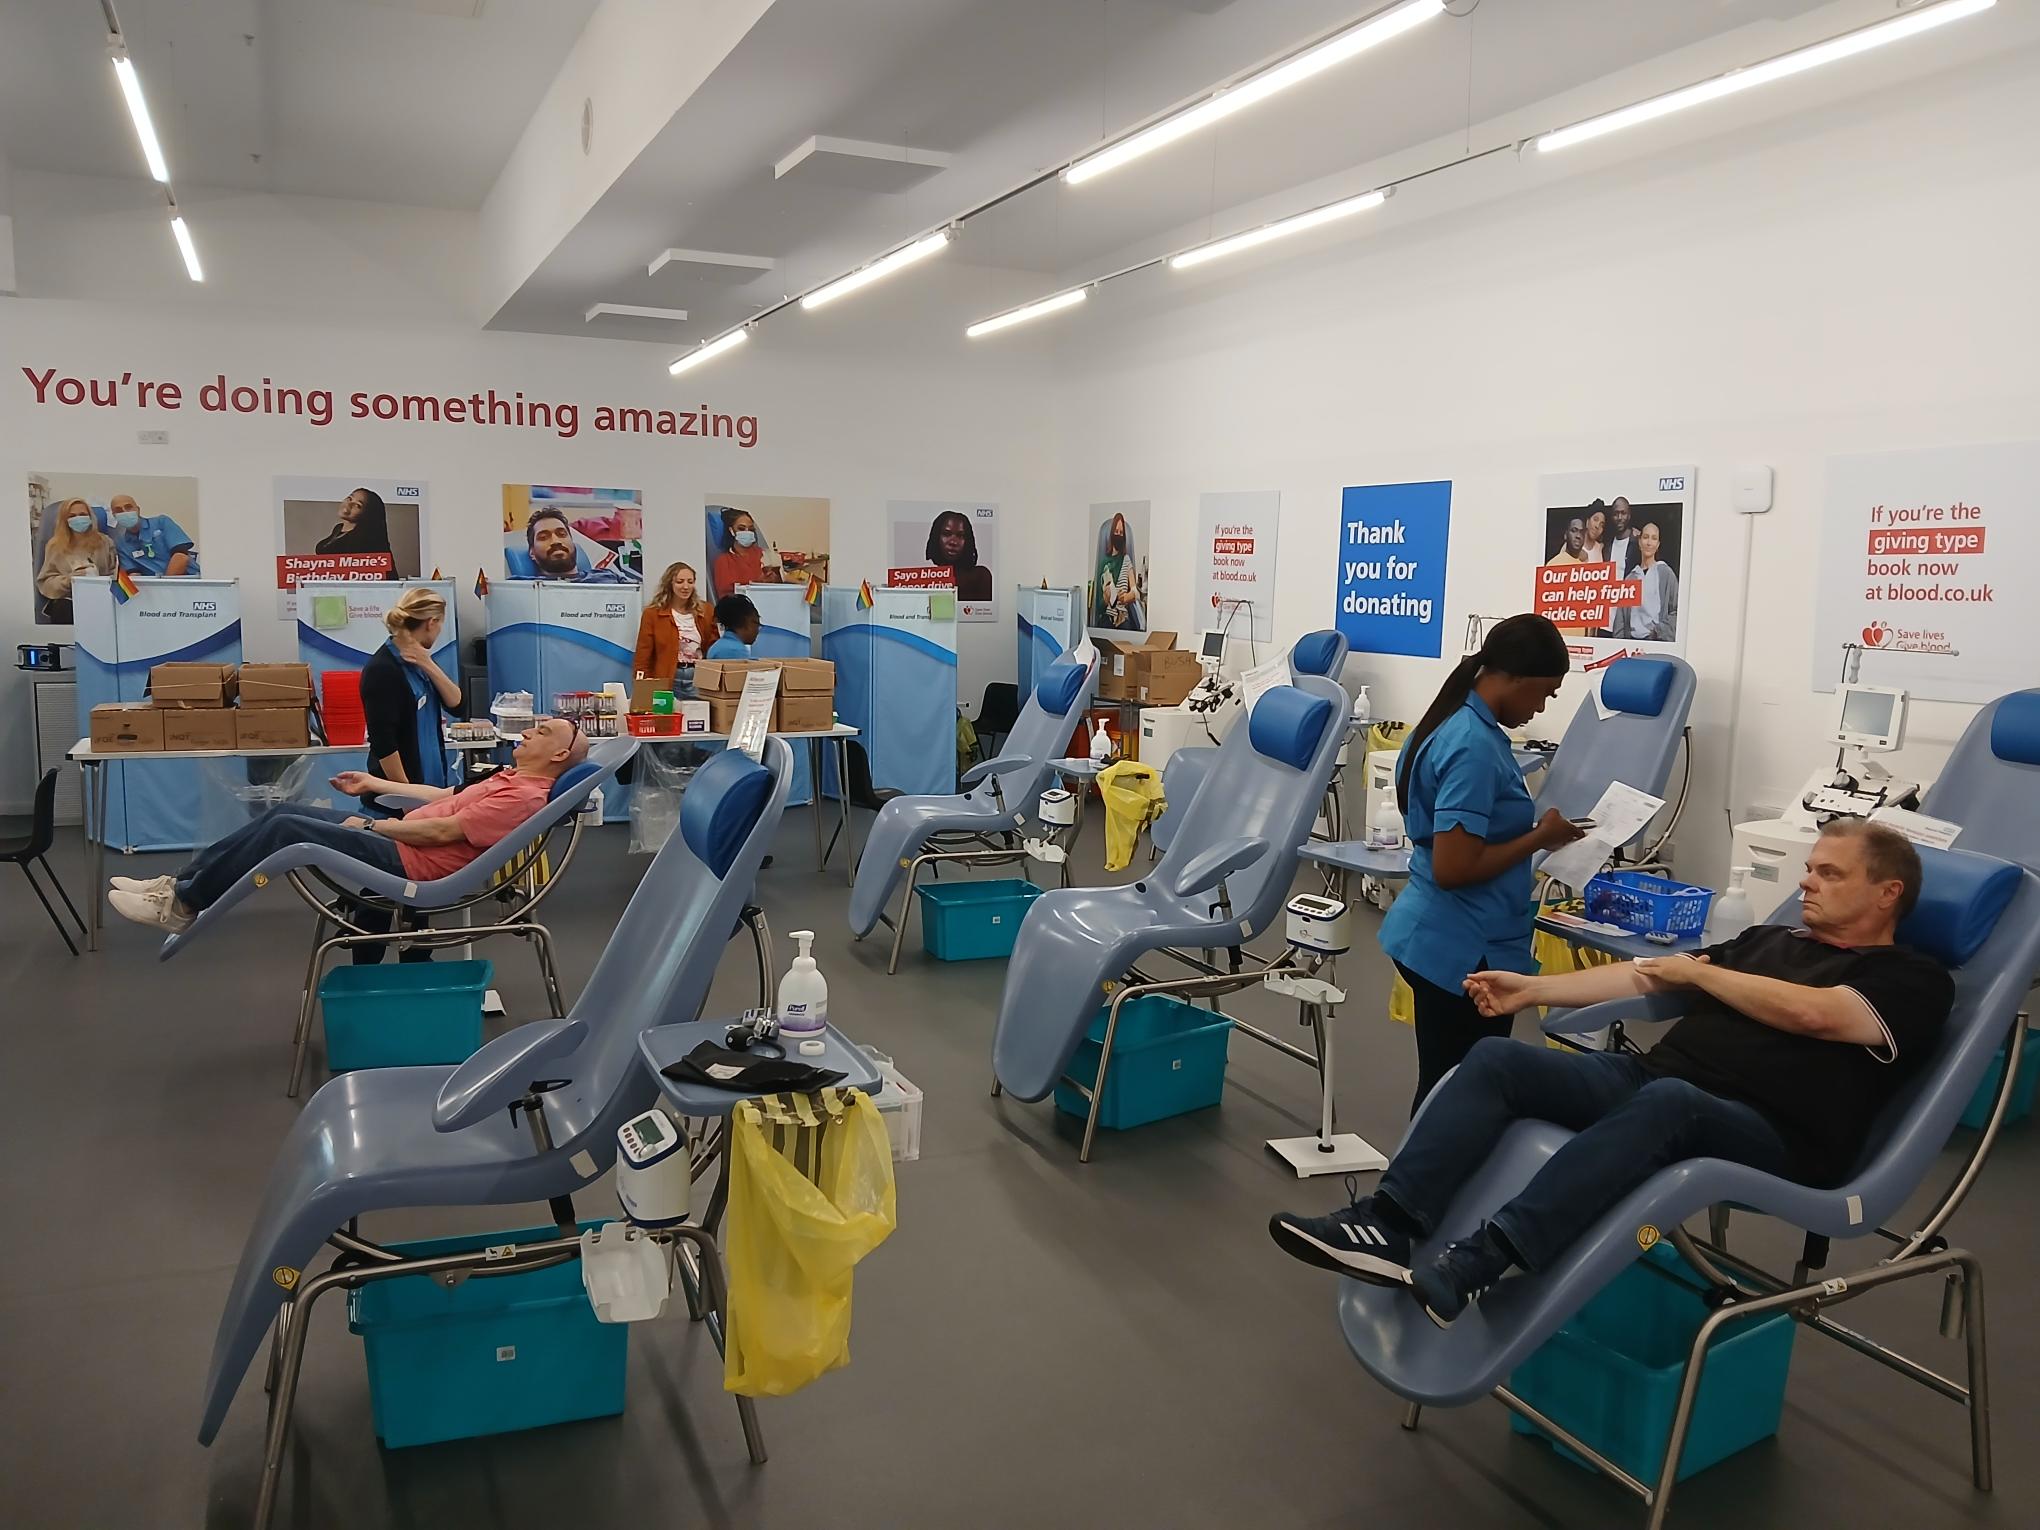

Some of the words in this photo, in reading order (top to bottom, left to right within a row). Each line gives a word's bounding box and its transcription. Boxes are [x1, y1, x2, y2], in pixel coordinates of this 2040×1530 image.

[21, 366, 182, 410] You’re
[199, 374, 334, 427] doing
[350, 389, 579, 438] something
[594, 404, 759, 448] amazing
[397, 487, 419, 496] NHS
[1659, 477, 1684, 491] NHS
[1871, 505, 1883, 522] If
[1887, 504, 1944, 527] you’re
[1950, 502, 1981, 520] the
[1215, 524, 1220, 535] If
[1242, 524, 1253, 535] the
[1347, 519, 1406, 545] Thank
[1215, 540, 1236, 553] giving
[1236, 541, 1252, 554] type
[1874, 531, 1929, 553] giving
[1935, 531, 1979, 553] type
[285, 558, 335, 571] Shayna
[338, 555, 388, 567] Marie’s
[1213, 556, 1229, 566] book
[1230, 559, 1245, 567] now
[1867, 558, 1911, 576] book
[1917, 562, 1959, 576] now
[348, 571, 383, 581] Drop
[893, 570, 918, 581] Sayo
[920, 567, 951, 579] blood
[1212, 571, 1219, 580] at
[1220, 570, 1257, 582] blood.co.uk
[1345, 561, 1380, 584] you
[1386, 555, 1417, 581] for
[1542, 569, 1567, 584] Our
[1569, 565, 1610, 583] blood
[1541, 589, 1564, 603] can
[1567, 586, 1597, 604] help
[1600, 583, 1636, 604] fight
[1865, 584, 1882, 601] at
[1887, 583, 1993, 602] blood.co.uk
[193, 602, 216, 610] NHS
[606, 604, 625, 612] NHS
[1342, 590, 1433, 623] donating
[1541, 607, 1576, 621] sickle
[1579, 605, 1604, 620] cell
[179, 611, 217, 619] Transplant
[1897, 628, 1921, 639] Save
[1922, 628, 1945, 640] lives
